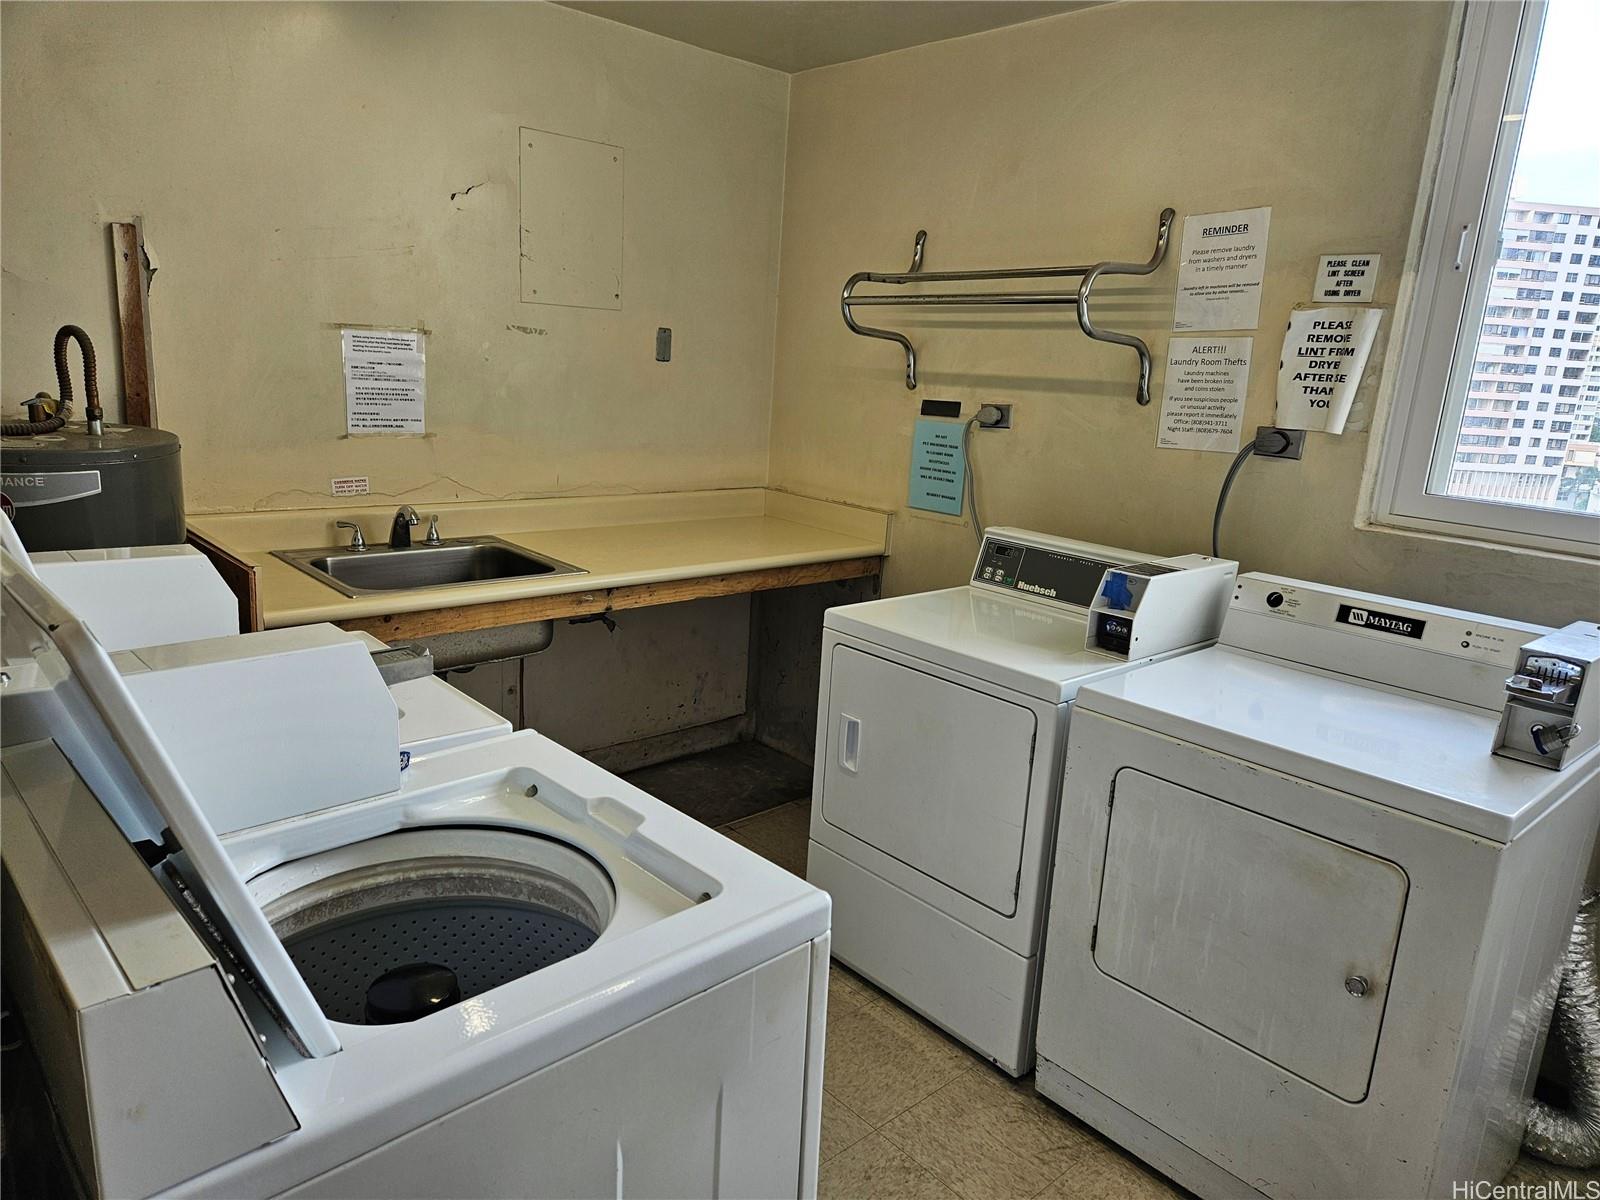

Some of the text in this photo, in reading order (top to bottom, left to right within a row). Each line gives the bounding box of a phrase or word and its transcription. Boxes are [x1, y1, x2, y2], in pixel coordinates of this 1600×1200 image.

[1202, 224, 1248, 236] REMINDER
[1313, 321, 1353, 330] PLEASE
[1192, 345, 1226, 354] ALERT!!!
[1298, 347, 1355, 356] LINT FRM
[1170, 358, 1199, 367] Laundry
[1293, 373, 1334, 382] AFTER
[1018, 581, 1056, 597] Huebsch
[1368, 616, 1412, 632] MAYTAG
